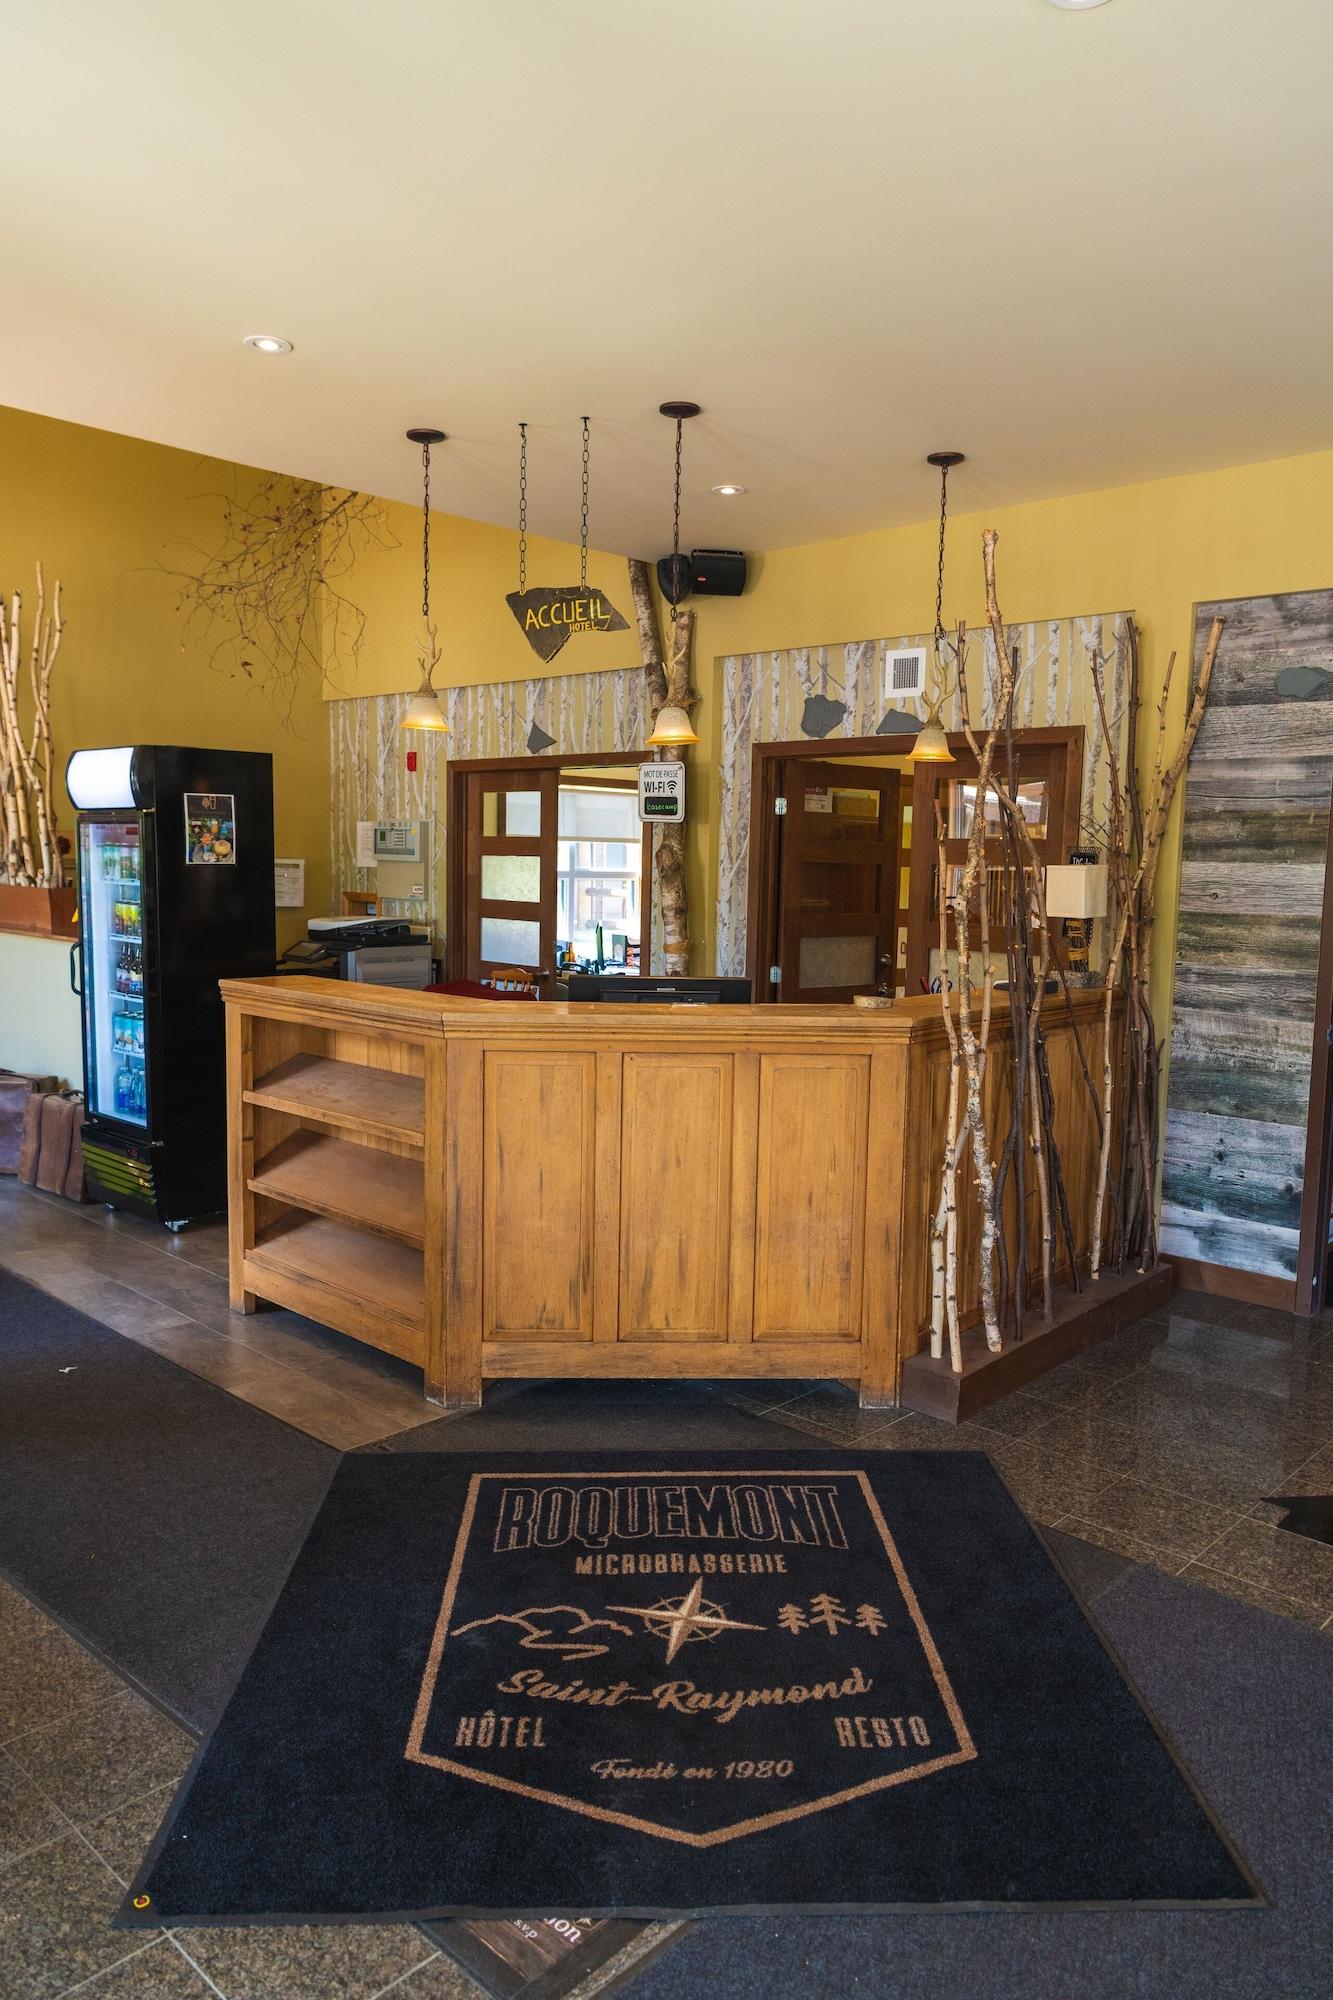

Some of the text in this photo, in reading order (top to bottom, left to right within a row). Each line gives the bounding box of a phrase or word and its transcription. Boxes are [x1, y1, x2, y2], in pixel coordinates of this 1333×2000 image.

[525, 598, 610, 630] ACCUEIL
[569, 621, 599, 633] HOTEL
[643, 770, 678, 778] MOT DE PASSE
[644, 781, 665, 793] WI-FI
[494, 1484, 849, 1552] ROQUEMONT
[575, 1552, 788, 1575] MICROBRASSERIE
[497, 1667, 873, 1724] Saint-Raymond
[455, 1709, 546, 1748] HÔTEL
[834, 1715, 921, 1748] RESTO
[682, 1767, 717, 1779] en
[724, 1759, 794, 1779] 1980
